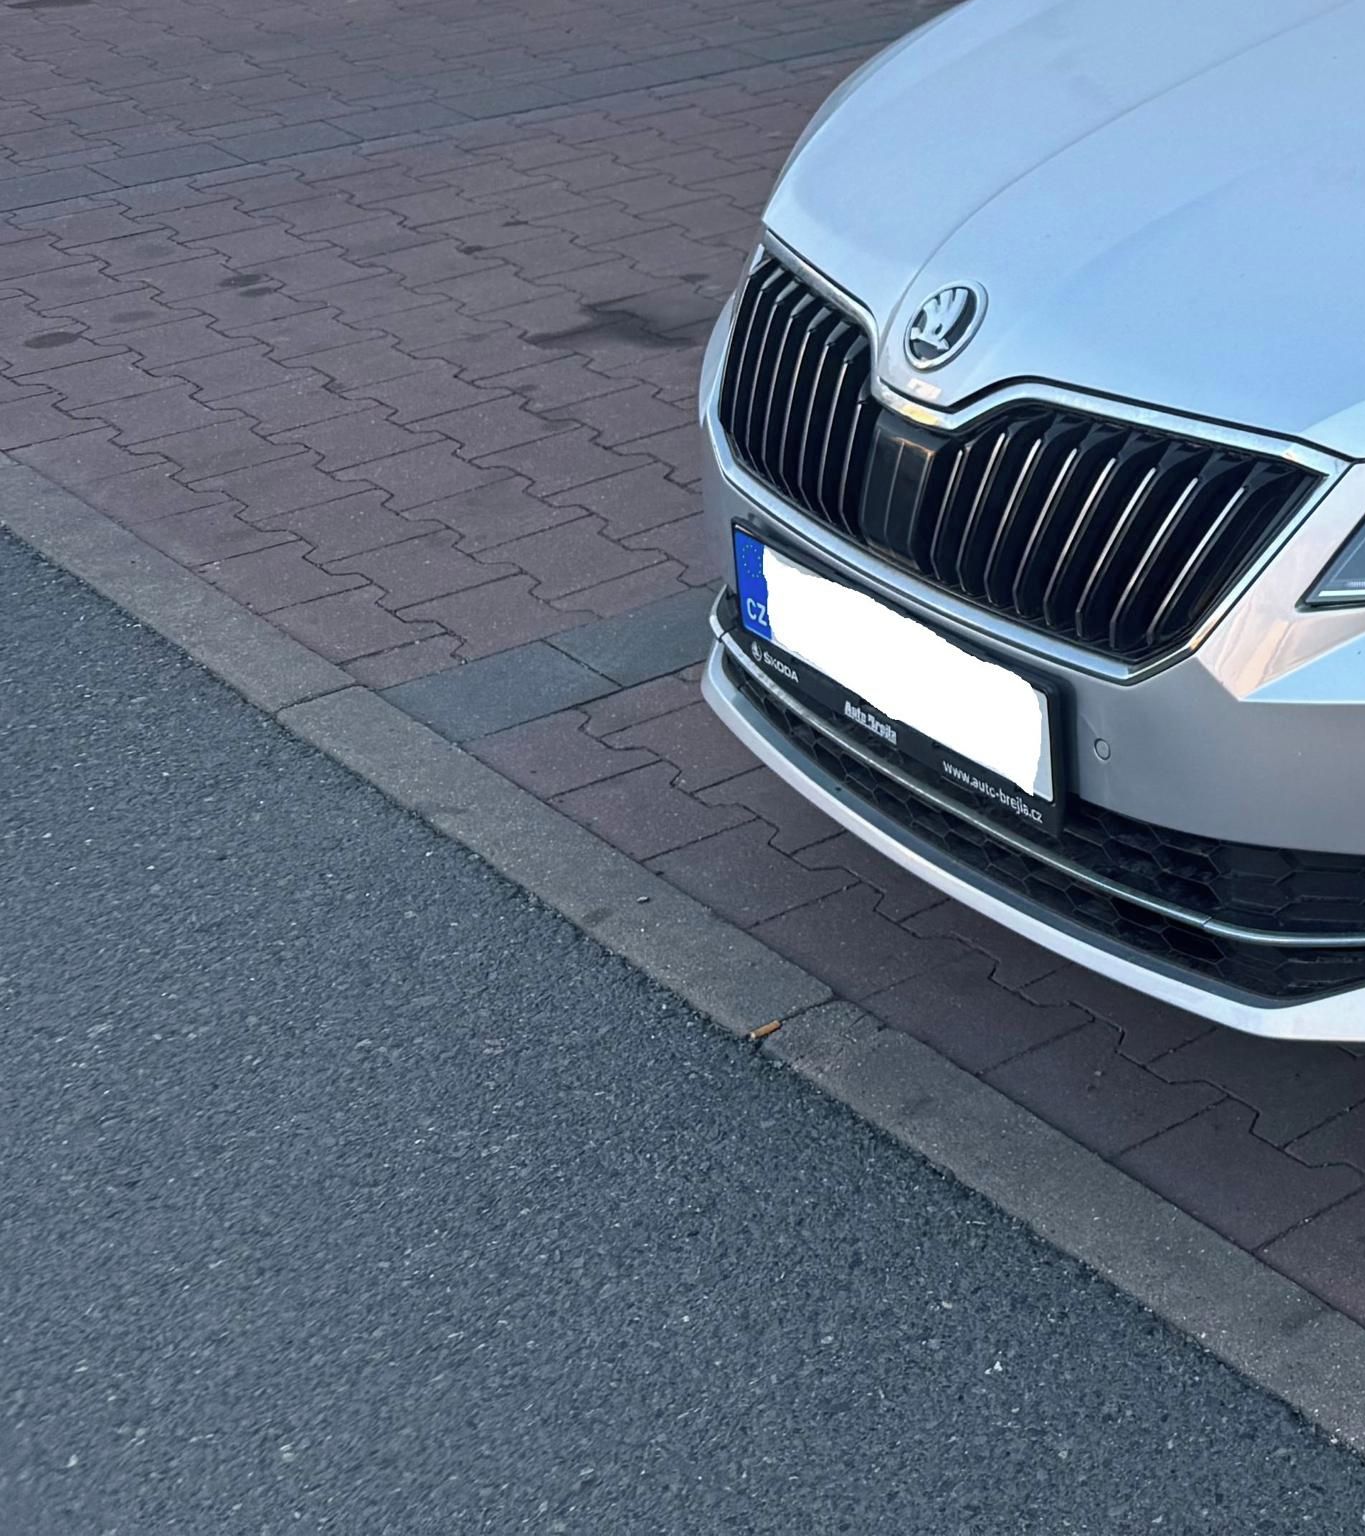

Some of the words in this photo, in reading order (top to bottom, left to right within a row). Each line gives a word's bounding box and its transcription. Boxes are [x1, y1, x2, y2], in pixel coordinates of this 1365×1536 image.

[746, 597, 768, 627] CZ
[763, 651, 799, 684] ŠKODA
[844, 700, 868, 727] Auto
[942, 759, 1044, 824] www.auto-brejla.cz
